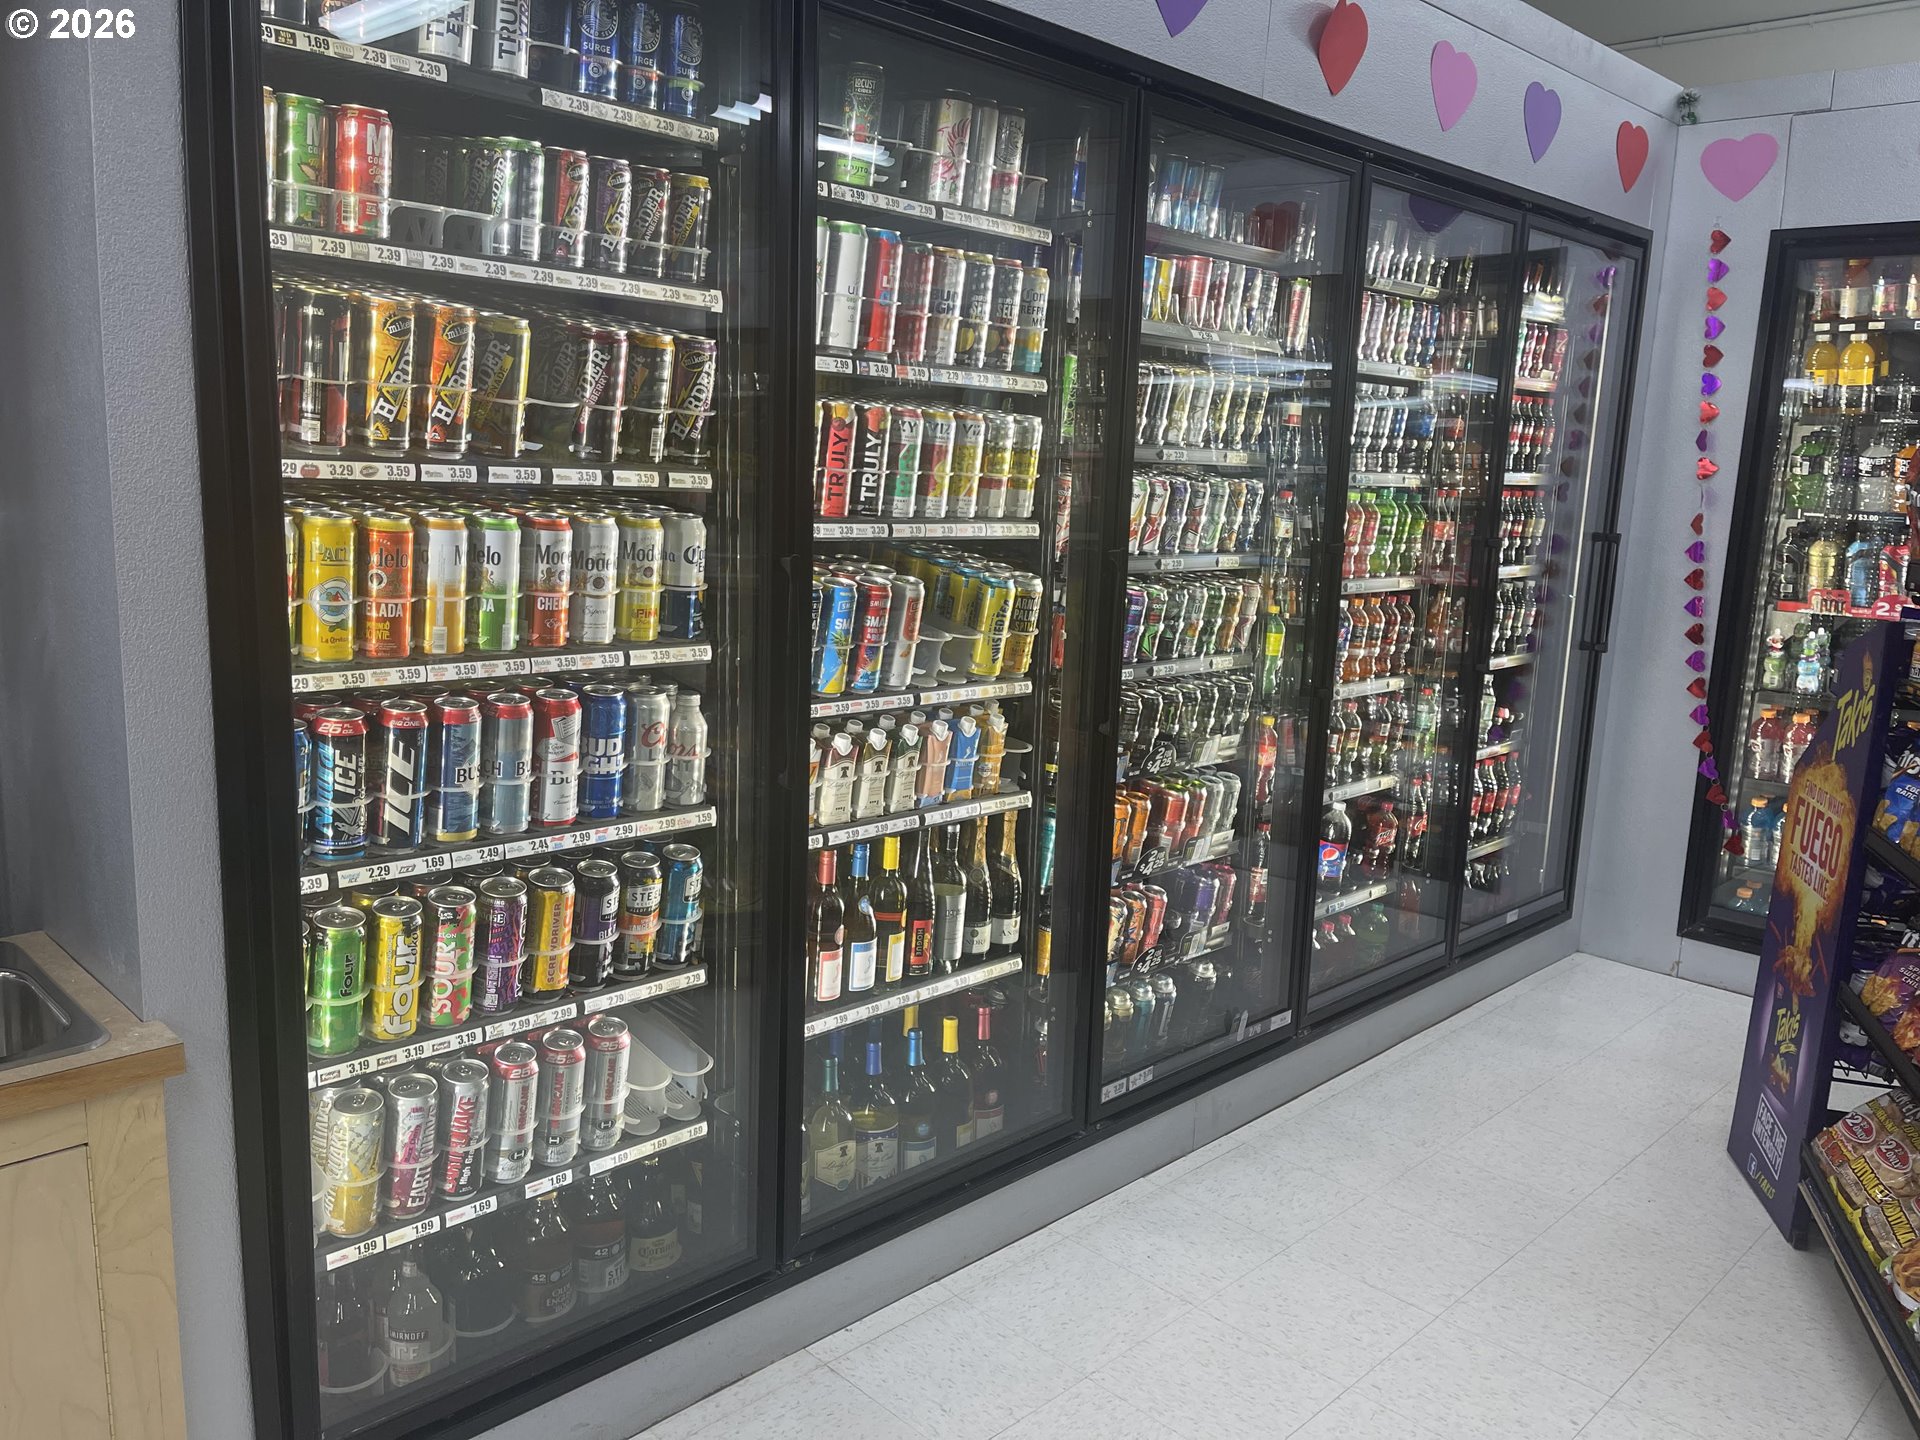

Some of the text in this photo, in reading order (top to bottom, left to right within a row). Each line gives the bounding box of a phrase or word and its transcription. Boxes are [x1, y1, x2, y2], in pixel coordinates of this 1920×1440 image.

[499, 0, 519, 59] TRUL
[583, 42, 611, 54] SURGE
[854, 79, 876, 89] LOCUST
[827, 432, 849, 500] TRULY
[860, 430, 882, 502] TRULY
[1876, 602, 1890, 616] 2
[992, 600, 1010, 664] TWISTED TEA
[318, 723, 342, 733] 26
[1832, 685, 1876, 762] Takis
[1158, 747, 1164, 756] 2
[334, 749, 357, 796] ICE
[384, 741, 414, 835] ICE
[1818, 787, 1828, 807] OUT
[1791, 796, 1843, 878] FUEGO
[1151, 851, 1157, 861] 2
[1791, 851, 1829, 900] TASTES LIKE
[547, 903, 562, 984] SCREWDRIVER
[1148, 949, 1154, 960] 2
[385, 934, 411, 1036] four
[431, 942, 455, 1014] SOUR
[1775, 1007, 1800, 1045] Takis
[511, 1070, 530, 1078] 25
[546, 1053, 567, 1064] 25
[1757, 1102, 1785, 1149] FACE THE
[459, 1162, 468, 1185] High
[1886, 1152, 1902, 1168] ONLY
[1759, 1173, 1775, 1200] TAKIS
[594, 1248, 608, 1257] 42
